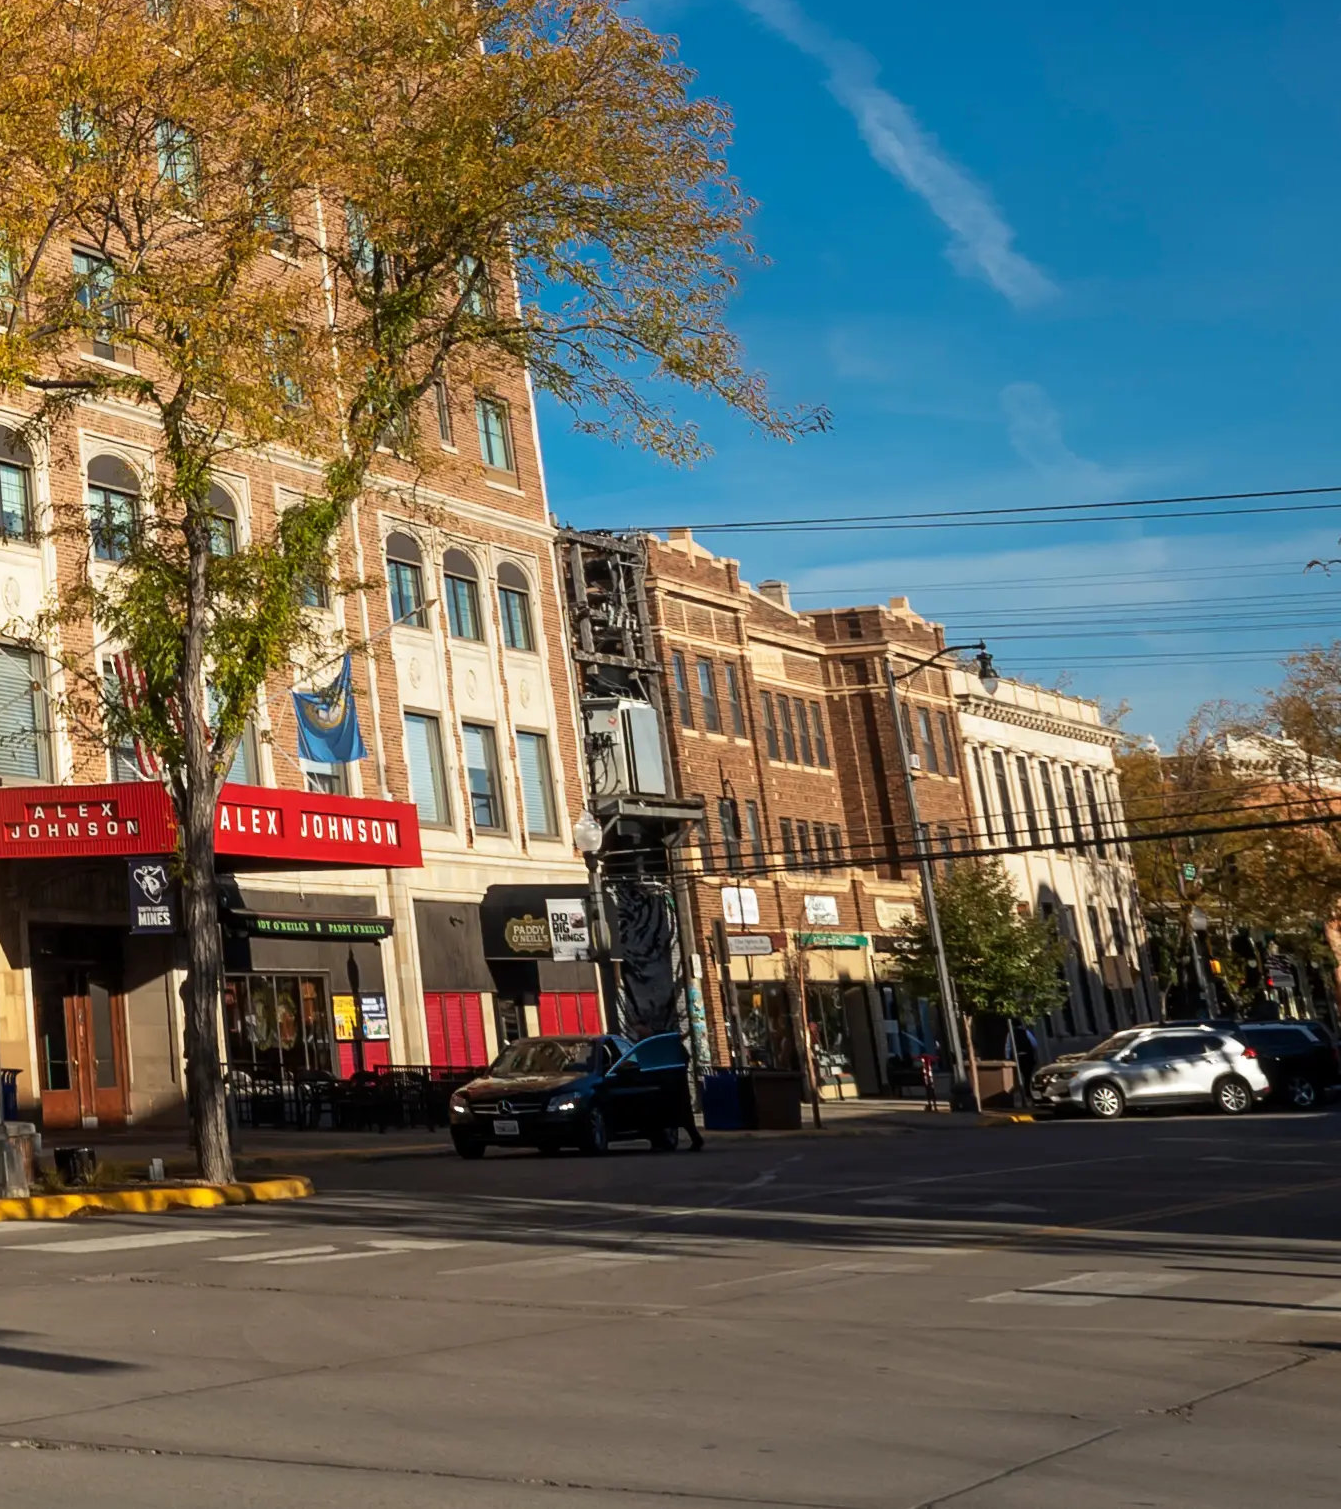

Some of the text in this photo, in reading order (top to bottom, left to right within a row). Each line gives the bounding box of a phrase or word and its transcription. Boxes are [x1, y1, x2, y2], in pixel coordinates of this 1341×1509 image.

[33, 803, 113, 820] ALEX
[11, 820, 140, 839] JOHNSON
[220, 805, 398, 845] ALEX JOHNSON
[138, 912, 171, 926] MINES
[551, 913, 568, 921] DO
[273, 920, 310, 932] O'NEILL'S
[328, 923, 352, 934] PADDY
[353, 924, 386, 935] O'NEILL'S
[513, 925, 545, 934] PADDY
[553, 922, 570, 933] BIG
[512, 934, 549, 943] O'NEILL'S
[554, 933, 585, 942] THINGS
